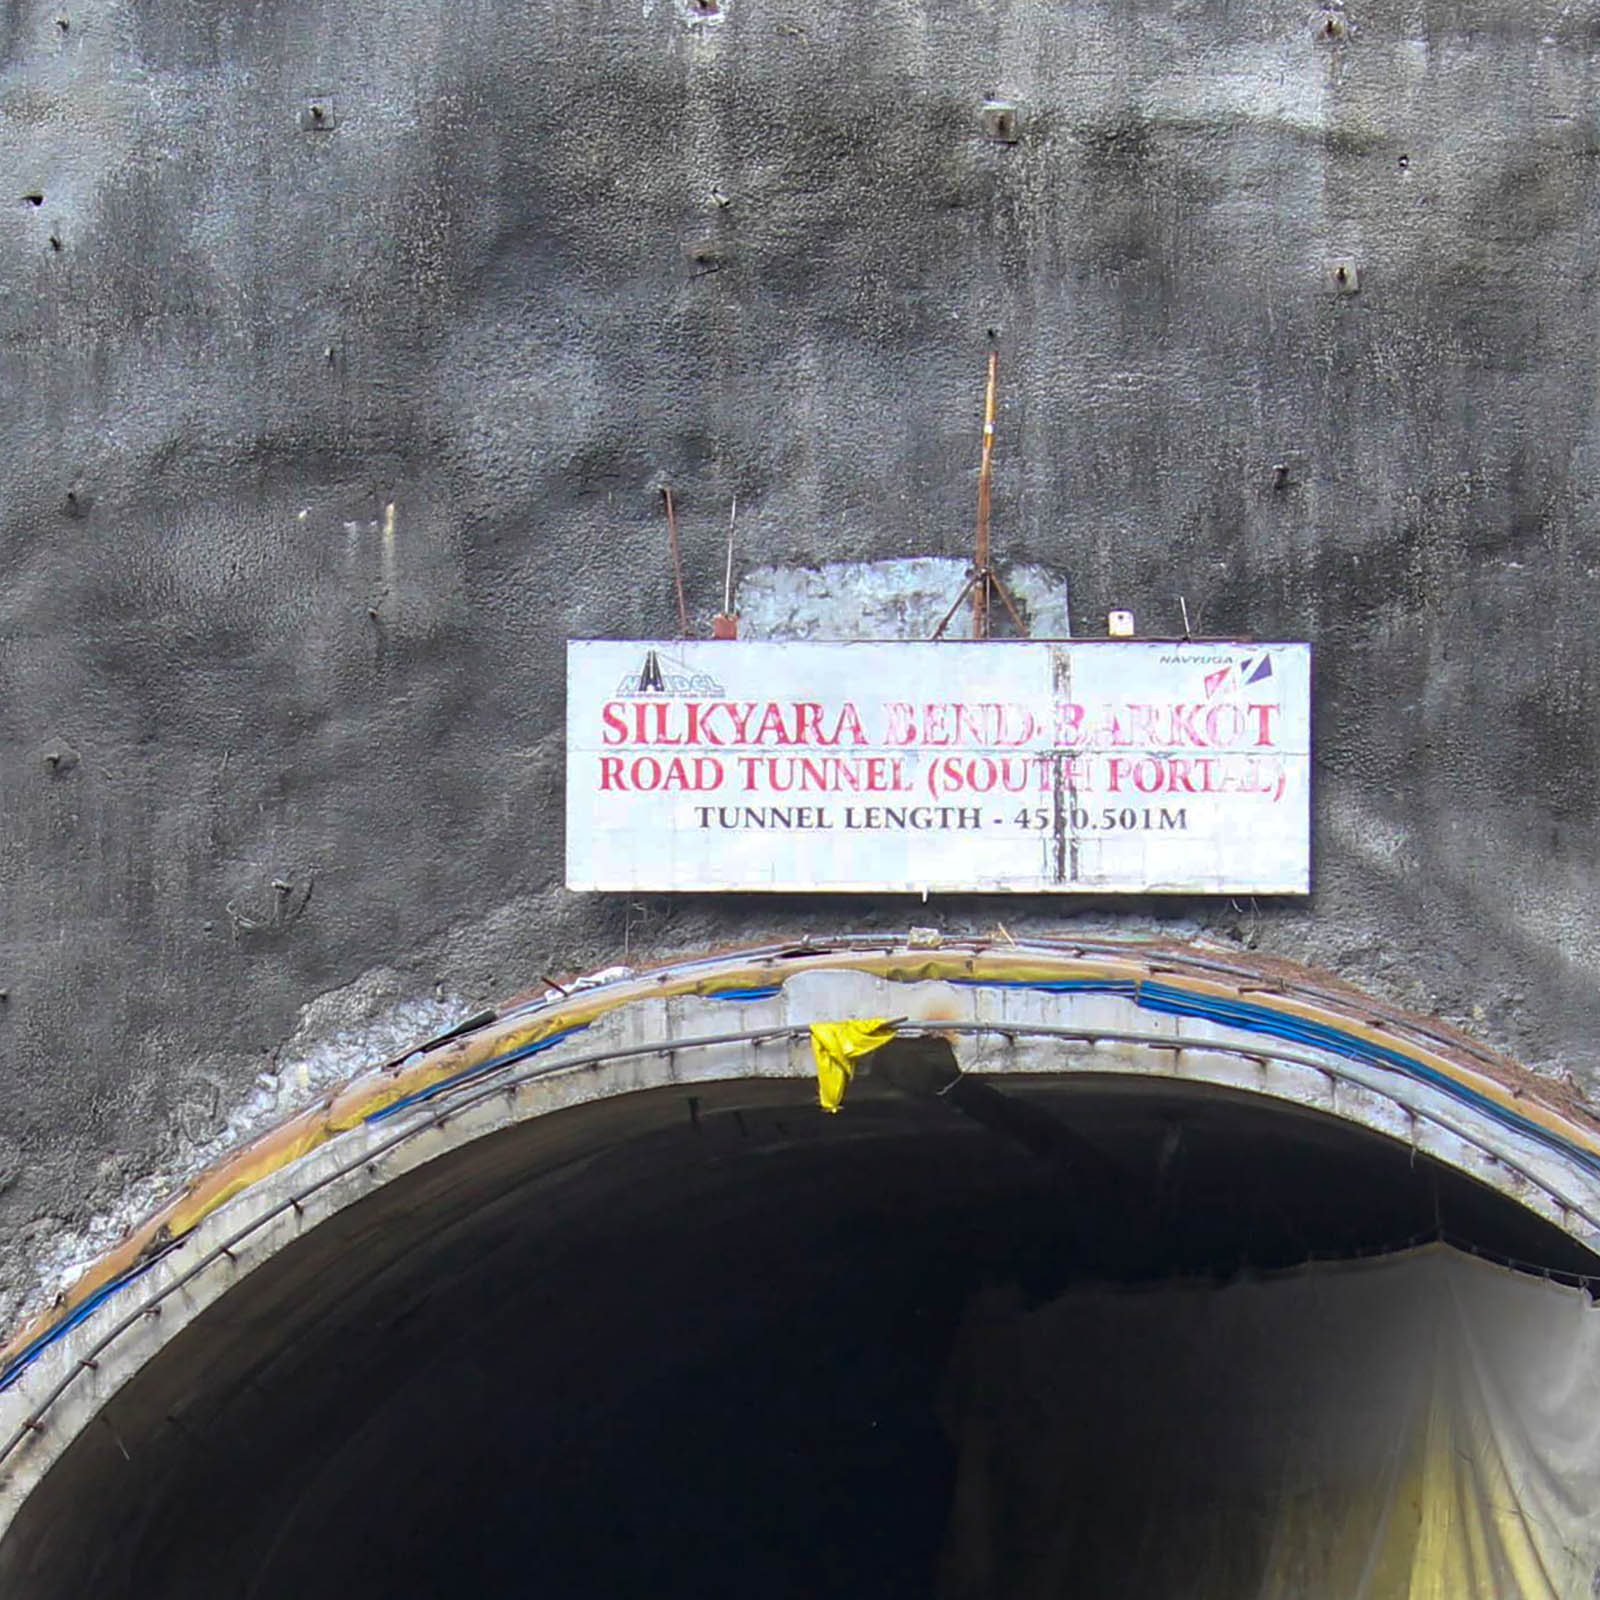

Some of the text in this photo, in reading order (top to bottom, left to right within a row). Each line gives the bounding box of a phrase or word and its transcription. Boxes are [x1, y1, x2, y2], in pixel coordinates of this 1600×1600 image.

[602, 702, 869, 746] SILKYARA
[599, 756, 725, 791] ROAD
[738, 757, 913, 791] TUNNEL
[927, 756, 1094, 800] (SOUTH
[695, 806, 833, 829] TUNNEL
[845, 806, 982, 830] LENGTH
